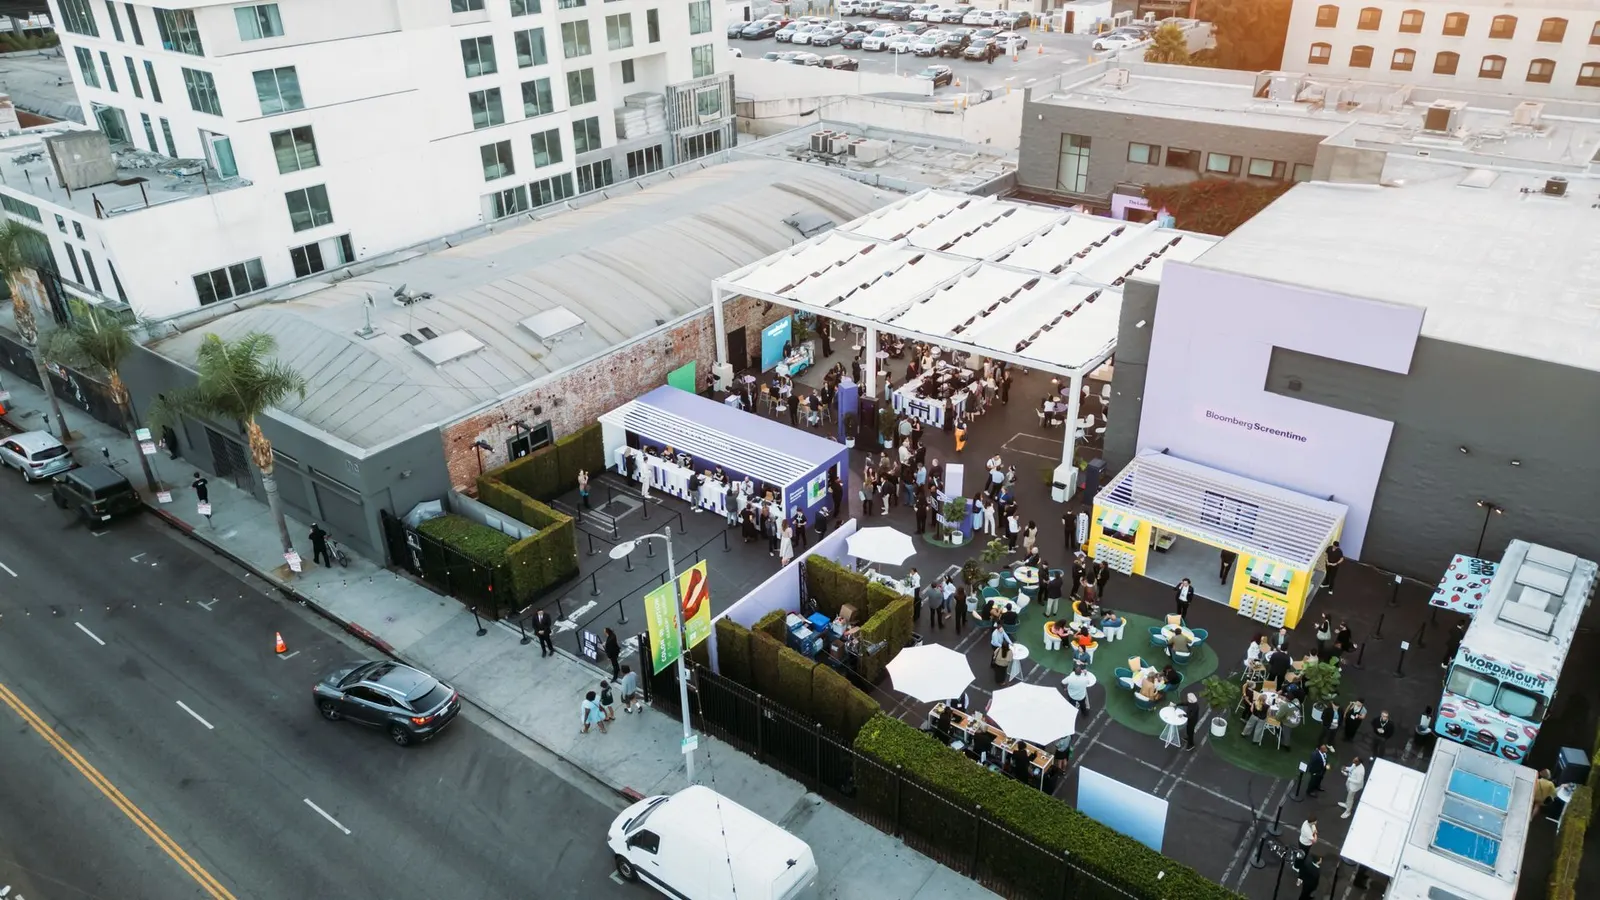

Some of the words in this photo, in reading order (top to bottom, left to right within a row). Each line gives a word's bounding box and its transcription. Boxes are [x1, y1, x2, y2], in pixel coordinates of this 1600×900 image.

[1206, 410, 1253, 430] Bloomberg
[1254, 422, 1307, 442] Screentime
[1464, 654, 1500, 673] WORD
[1506, 668, 1545, 688] MOUTH
